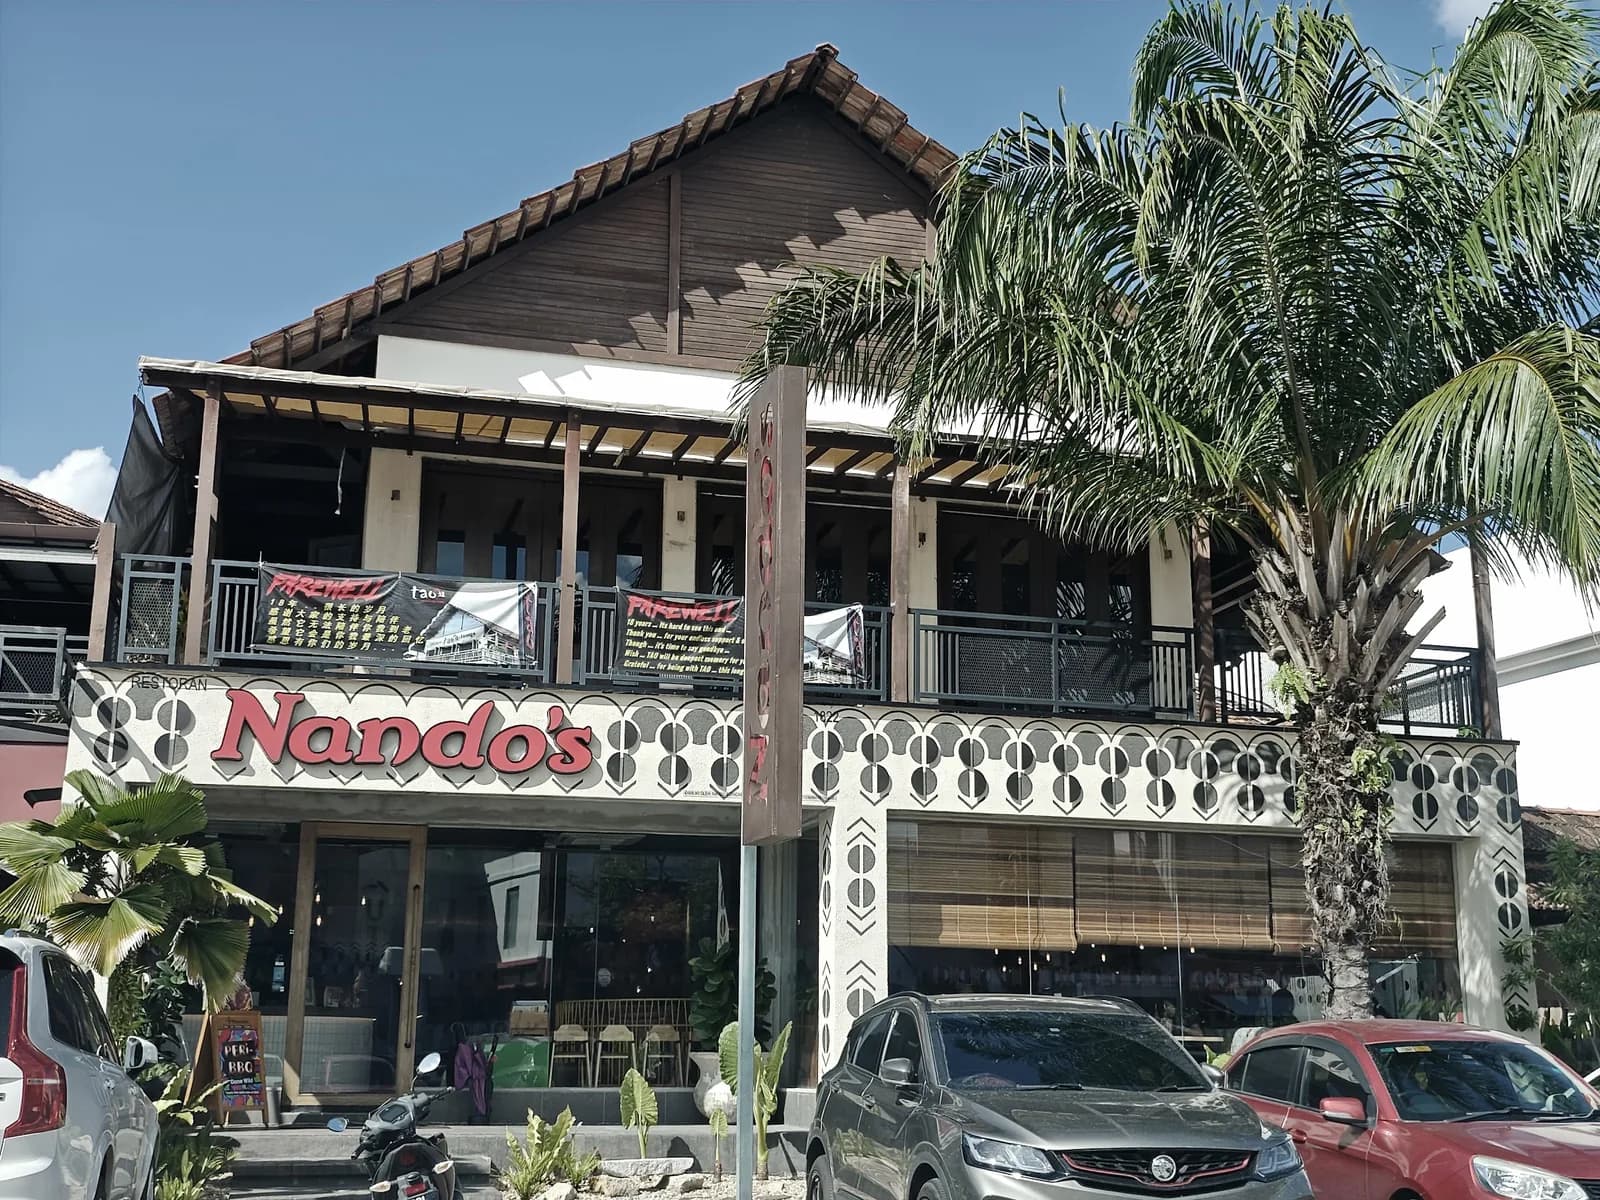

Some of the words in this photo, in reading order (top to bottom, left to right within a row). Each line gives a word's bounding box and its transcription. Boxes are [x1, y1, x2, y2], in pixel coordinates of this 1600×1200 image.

[266, 572, 385, 602] FAREWELL
[626, 594, 740, 623] FAREWELL
[669, 622, 683, 630] hard
[702, 624, 714, 632] this
[626, 629, 645, 638] Thank
[674, 634, 688, 642] your
[711, 637, 735, 645] support
[625, 638, 648, 649] Though
[698, 646, 725, 655] goodbye
[624, 649, 640, 658] Wish
[659, 652, 671, 660] will
[704, 656, 729, 665] memory
[656, 662, 667, 670] for
[667, 663, 685, 673] being
[131, 675, 208, 691] RESTORAN
[210, 688, 593, 774] Nando's
